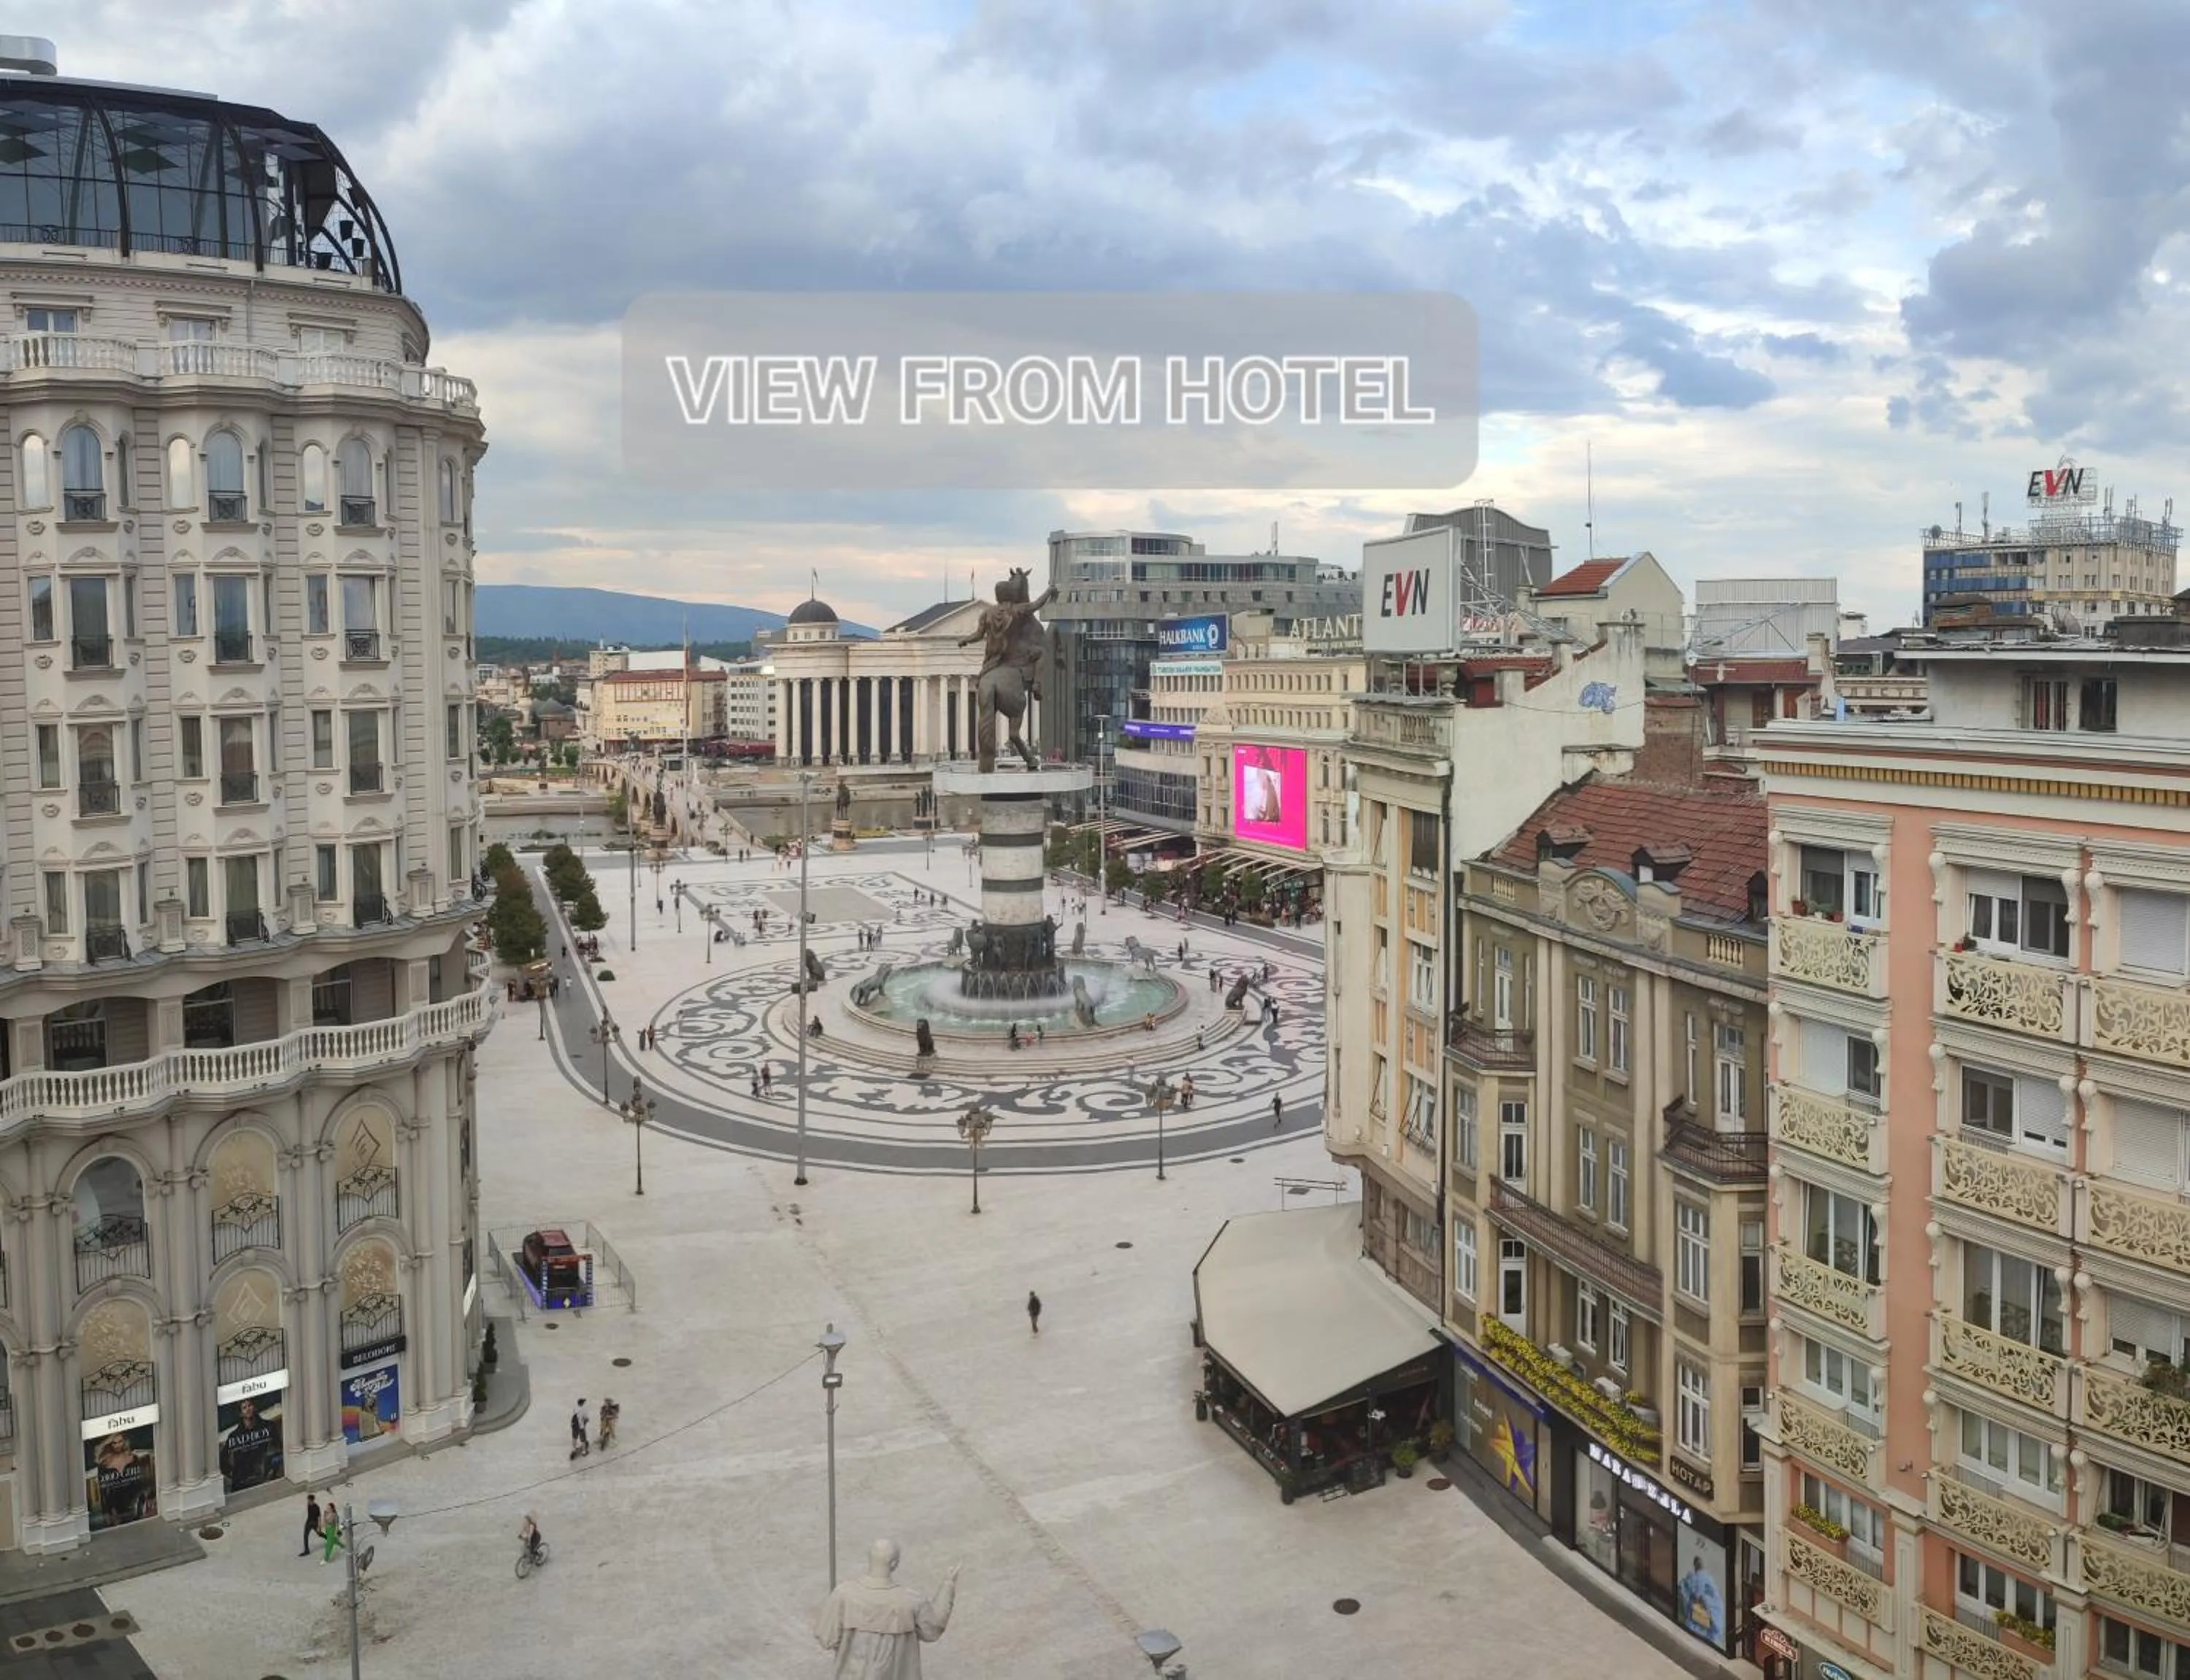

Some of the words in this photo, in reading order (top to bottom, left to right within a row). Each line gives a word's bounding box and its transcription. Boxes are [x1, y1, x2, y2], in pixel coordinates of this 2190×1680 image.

[2028, 468, 2083, 497] EVN
[1380, 568, 1429, 617] EVN
[1159, 628, 1206, 645] HALKBANK
